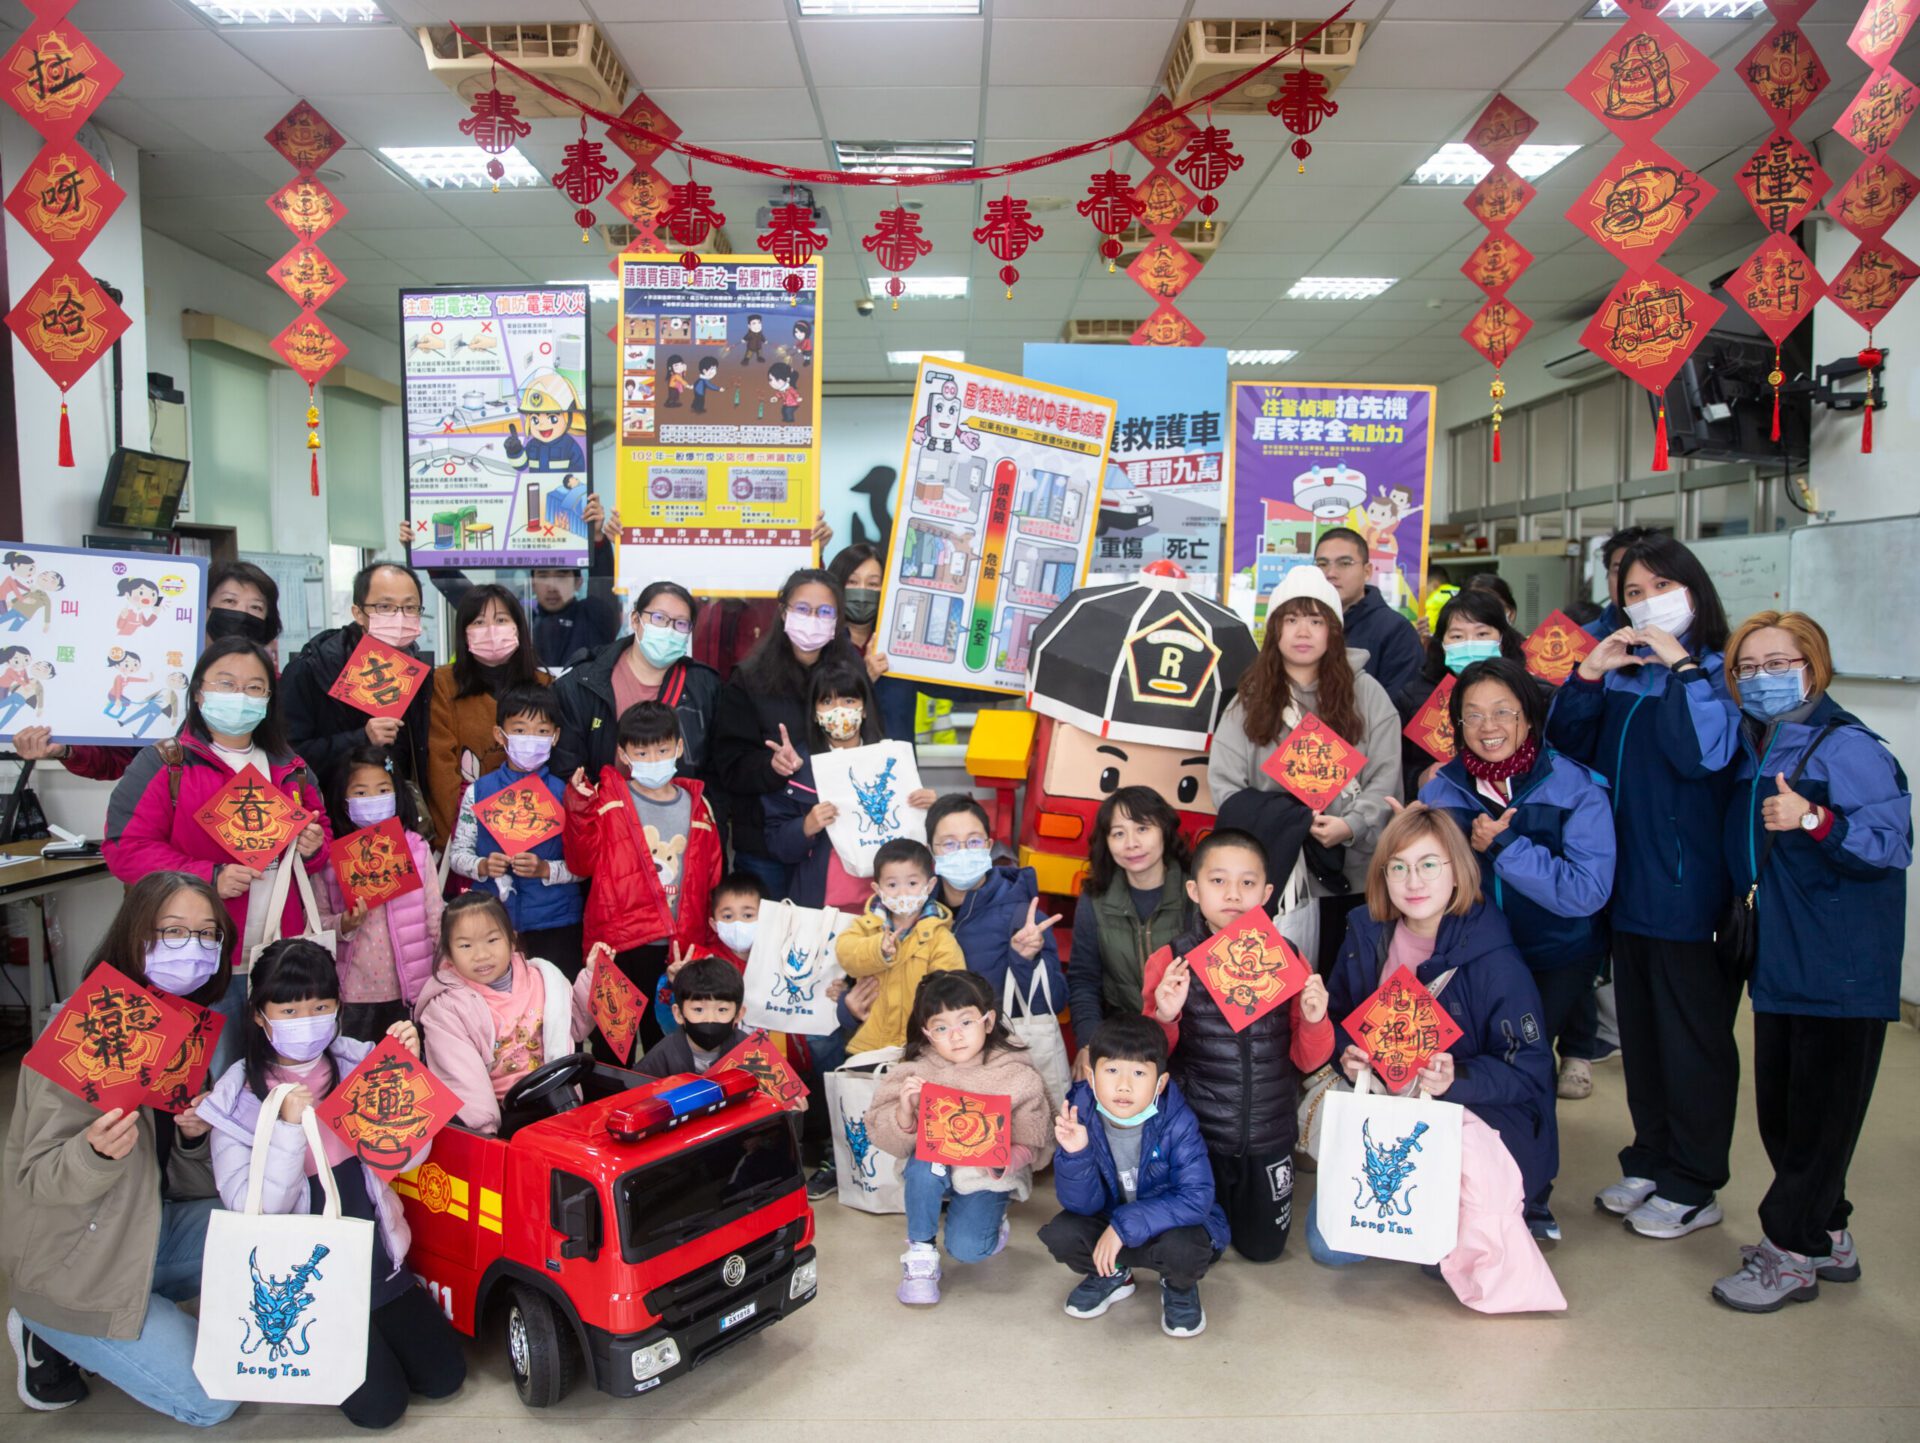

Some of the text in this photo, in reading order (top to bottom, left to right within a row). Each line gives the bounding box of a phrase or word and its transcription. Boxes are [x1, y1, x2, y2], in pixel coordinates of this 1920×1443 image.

[28, 50, 86, 101] 拉
[1856, 165, 1886, 189] 119
[41, 169, 85, 218] 呀
[1153, 243, 1177, 299] 大蛇丸
[42, 290, 86, 337] 哈
[403, 296, 490, 317] 注意用電安全
[1261, 395, 1408, 421] 住警偵測搶先機
[1252, 416, 1404, 443] 居家安全有助力
[1125, 454, 1221, 487] 重罰九萬
[992, 483, 1010, 525] 很危險
[1100, 537, 1210, 560] 重傷 死亡
[113, 564, 126, 574] 02
[983, 552, 999, 580] 危險
[61, 600, 79, 617] 叫
[176, 607, 193, 624] 叫
[973, 618, 988, 646] 安全
[1159, 647, 1184, 679] R
[359, 657, 401, 706] 吉
[228, 777, 275, 832] 春
